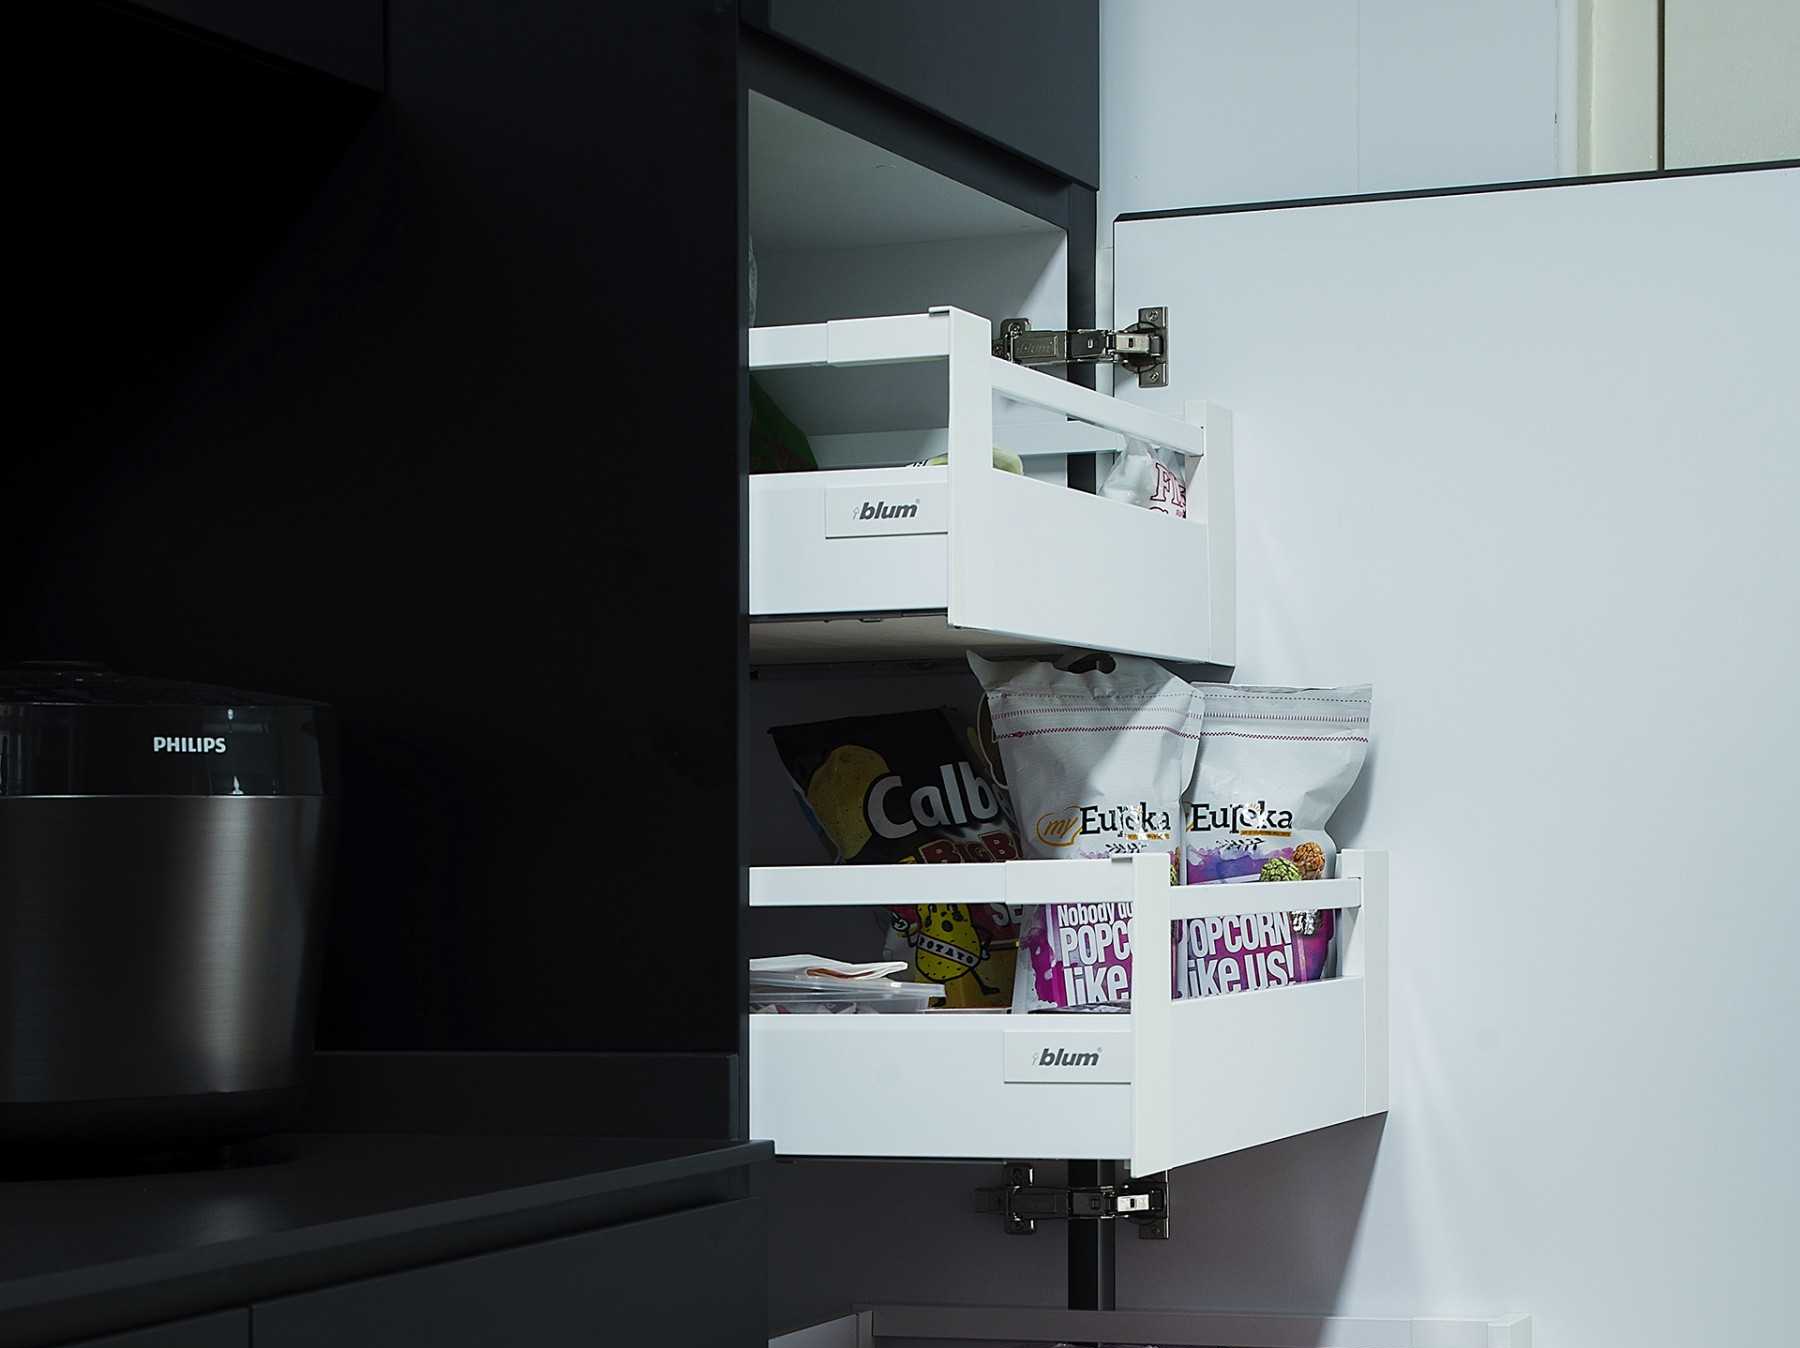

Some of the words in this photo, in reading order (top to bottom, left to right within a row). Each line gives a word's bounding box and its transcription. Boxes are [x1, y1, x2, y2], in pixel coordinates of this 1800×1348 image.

[859, 501, 918, 520] blum
[153, 736, 226, 753] PHILIPS
[867, 761, 999, 839] Calb
[1057, 902, 1116, 927] Nobody
[917, 935, 975, 965] POTATO
[1059, 919, 1133, 967] POPC
[1188, 910, 1292, 958] OPCORN
[1064, 964, 1130, 1008] like
[1188, 956, 1242, 998] ike
[1038, 1046, 1099, 1067] blum
